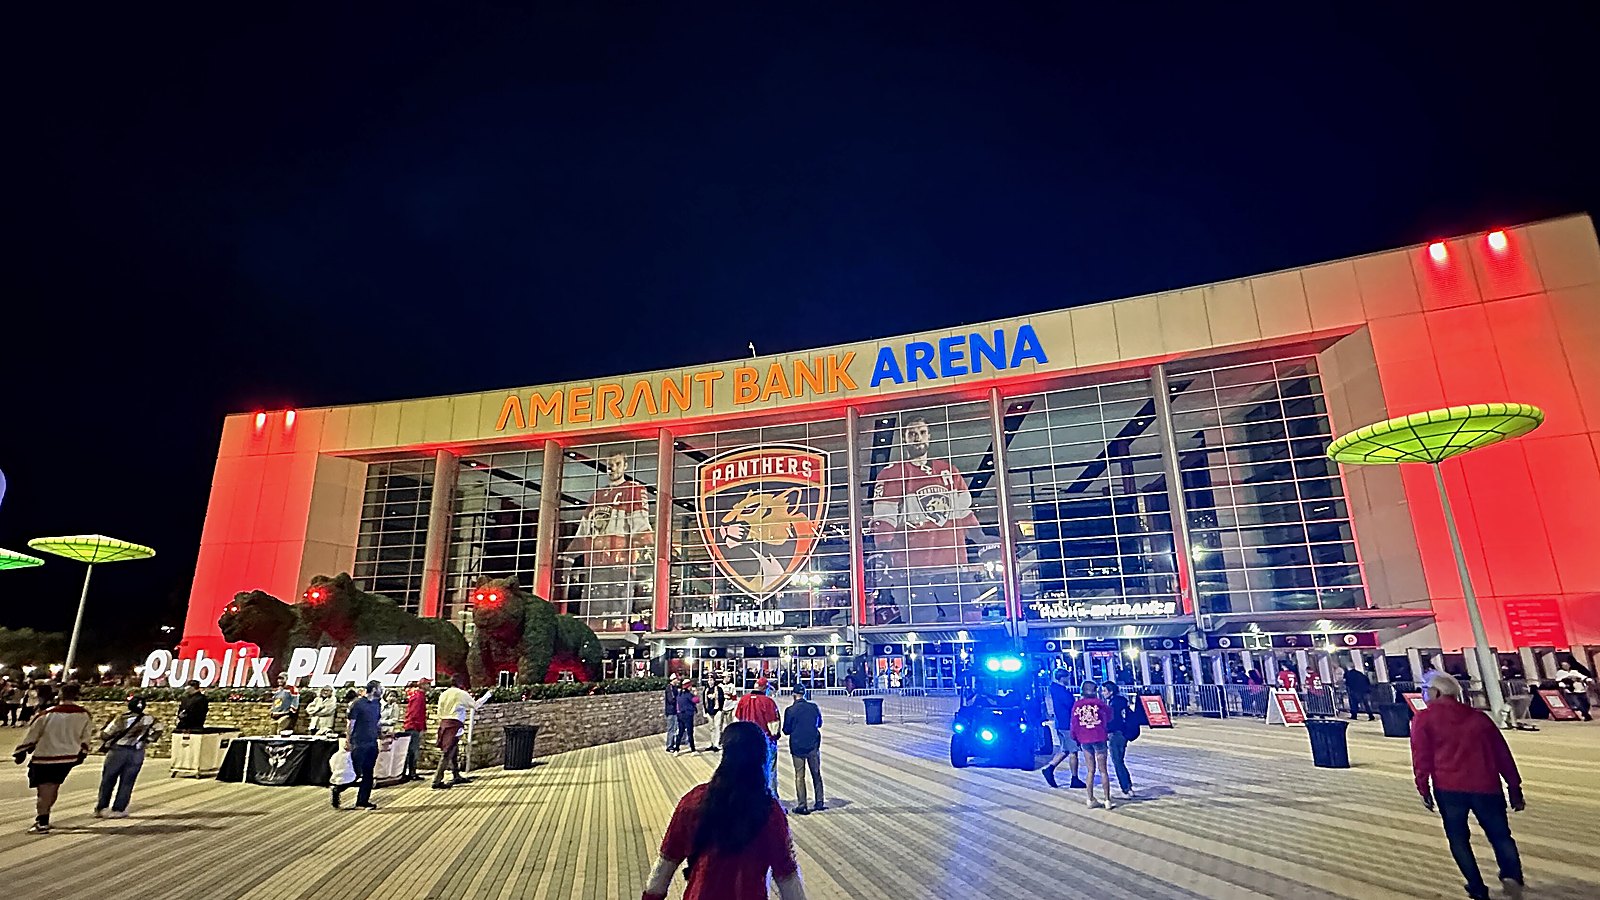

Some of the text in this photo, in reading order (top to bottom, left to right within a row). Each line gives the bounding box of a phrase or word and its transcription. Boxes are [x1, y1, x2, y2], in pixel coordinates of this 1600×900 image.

[495, 324, 1049, 431] AMERANT BANK ARENA
[712, 457, 812, 487] PANTHERS
[691, 610, 785, 628] PANTHERLAND
[141, 644, 436, 688] Publix PLAZA
